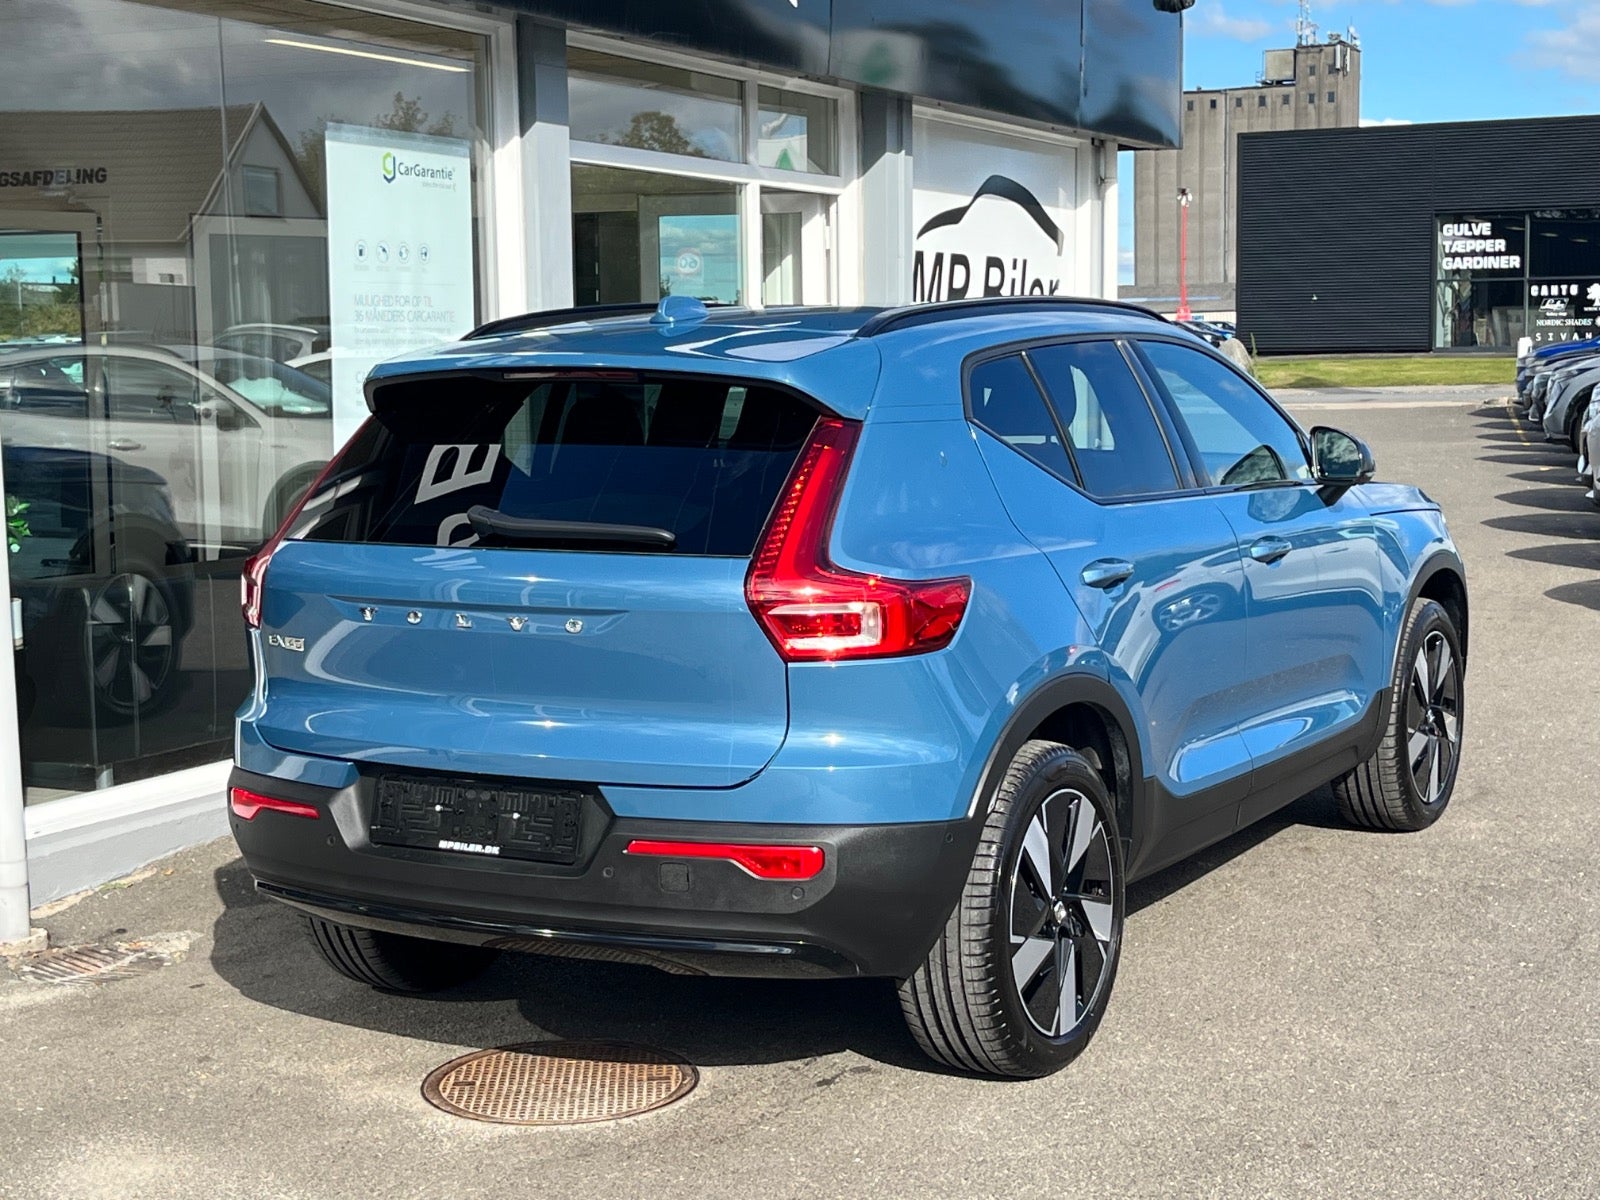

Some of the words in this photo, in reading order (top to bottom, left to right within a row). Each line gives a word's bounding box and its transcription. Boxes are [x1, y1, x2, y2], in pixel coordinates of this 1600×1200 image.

[398, 161, 454, 181] CarGarantie
[1442, 222, 1492, 237] GULVE
[1442, 239, 1506, 253] TÆPPER
[1442, 255, 1521, 270] GARDINER
[359, 606, 584, 634] VOLVO
